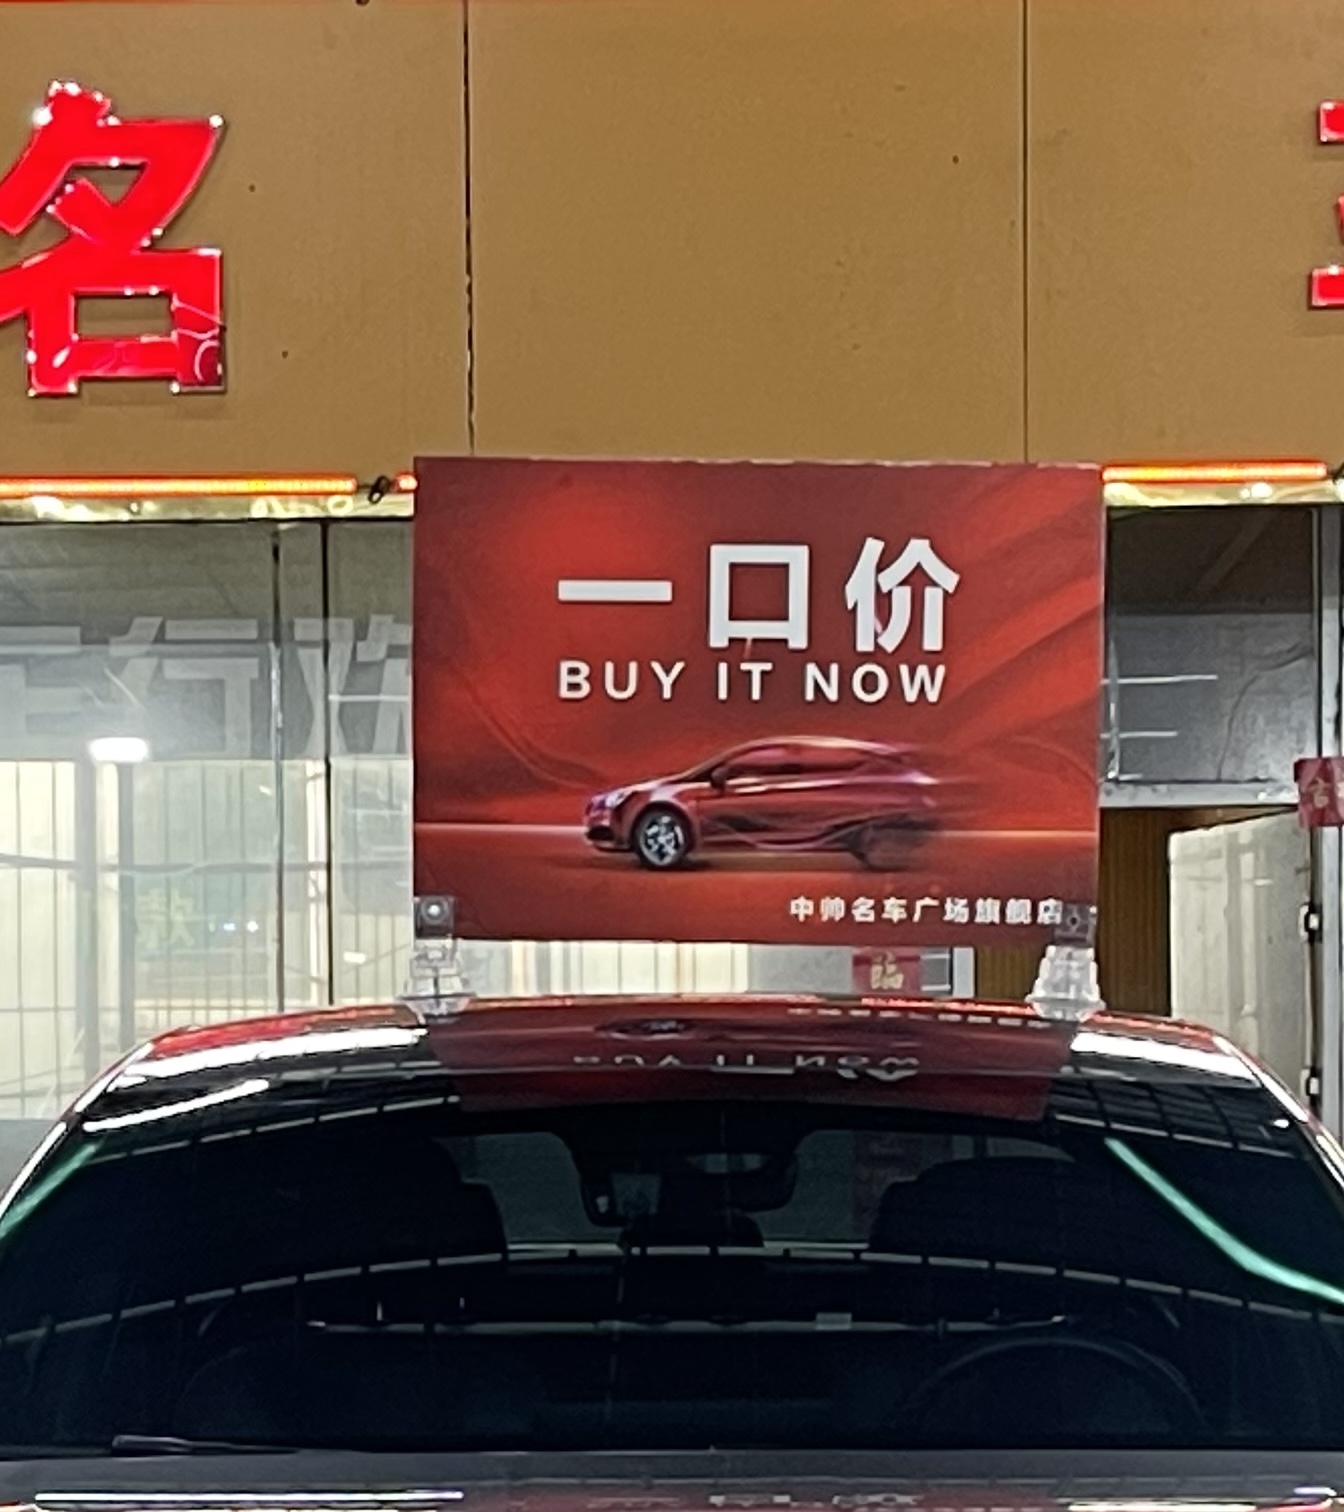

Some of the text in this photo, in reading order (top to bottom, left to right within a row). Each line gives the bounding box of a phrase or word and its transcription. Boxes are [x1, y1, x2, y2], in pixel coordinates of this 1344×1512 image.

[558, 537, 960, 653] 一口价
[559, 660, 947, 703] BUY IT NOW
[789, 896, 1064, 926] 中帅名车广场旗舰店
